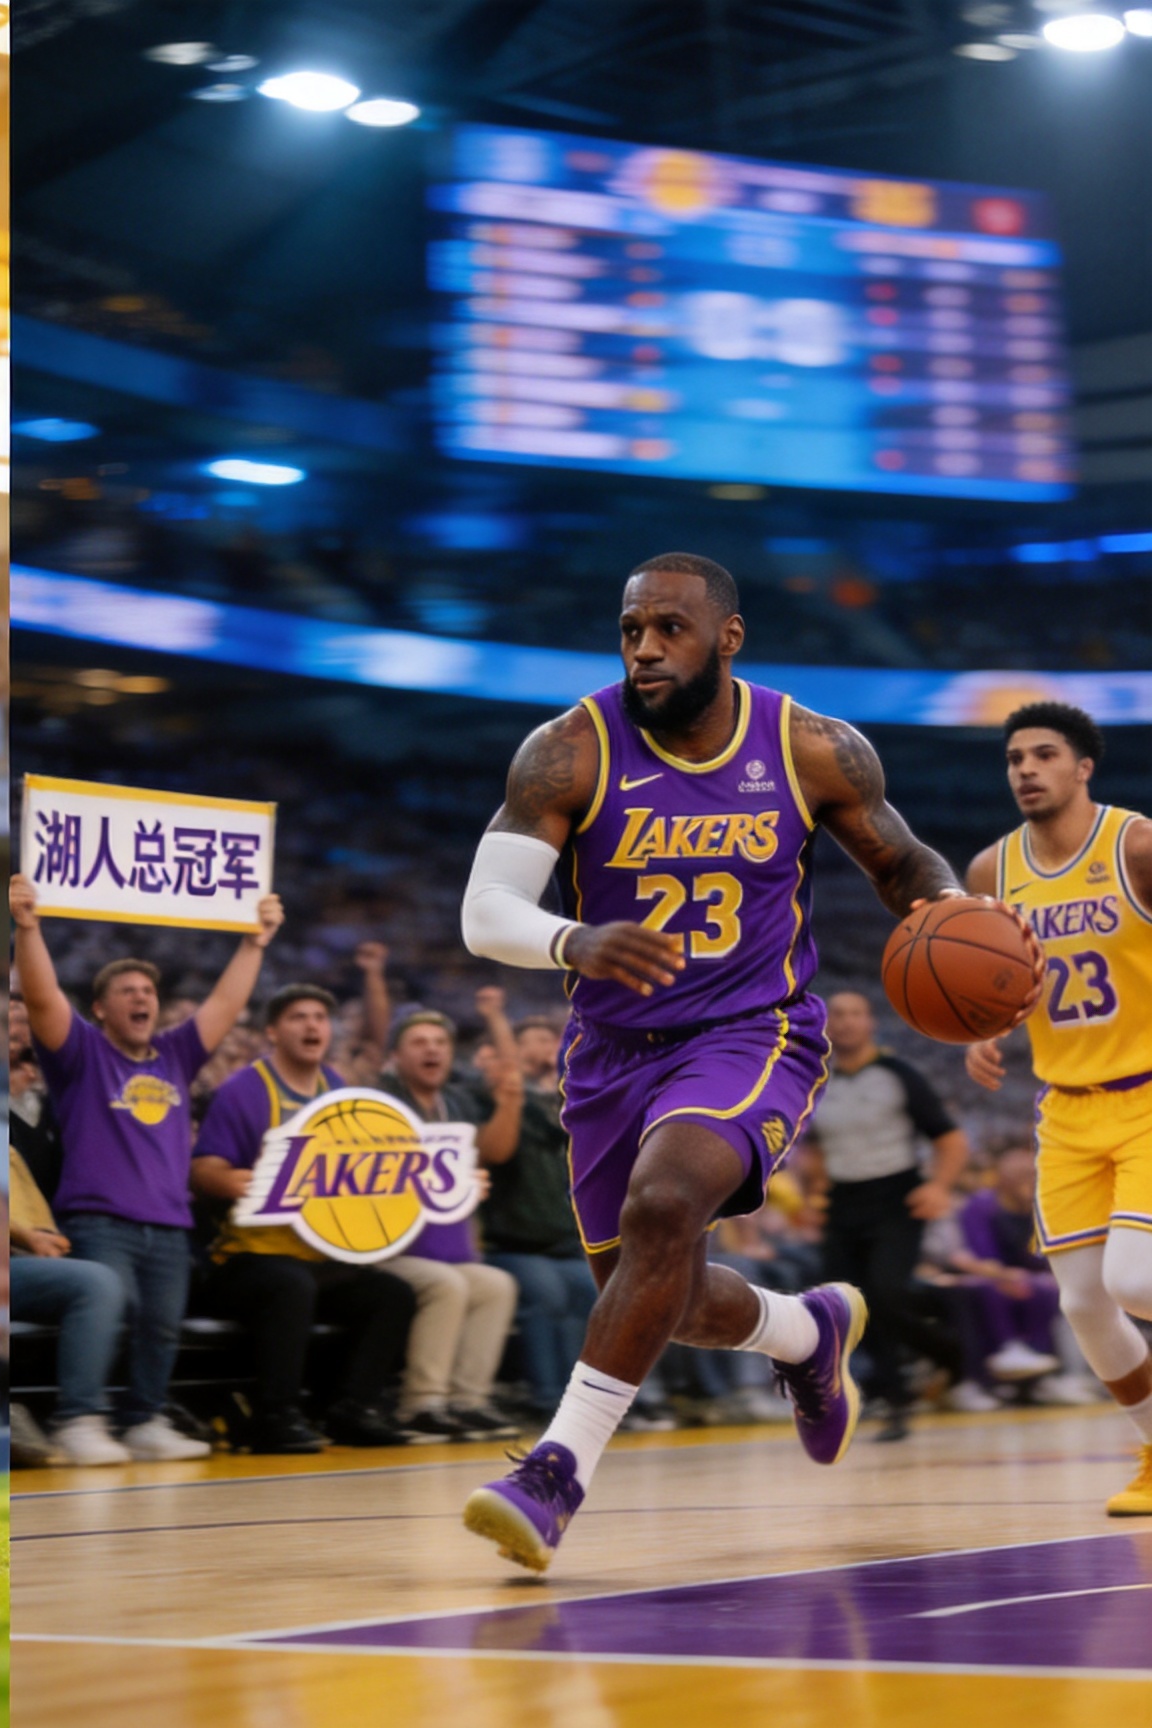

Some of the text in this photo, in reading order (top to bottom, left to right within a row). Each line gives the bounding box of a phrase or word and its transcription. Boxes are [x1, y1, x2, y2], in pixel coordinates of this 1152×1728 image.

[33, 809, 261, 900] 湖人总冠军
[602, 807, 780, 869] LAKERS
[635, 871, 743, 959] 23
[1047, 950, 1117, 1023] 23
[252, 1134, 472, 1214] LAKERS
